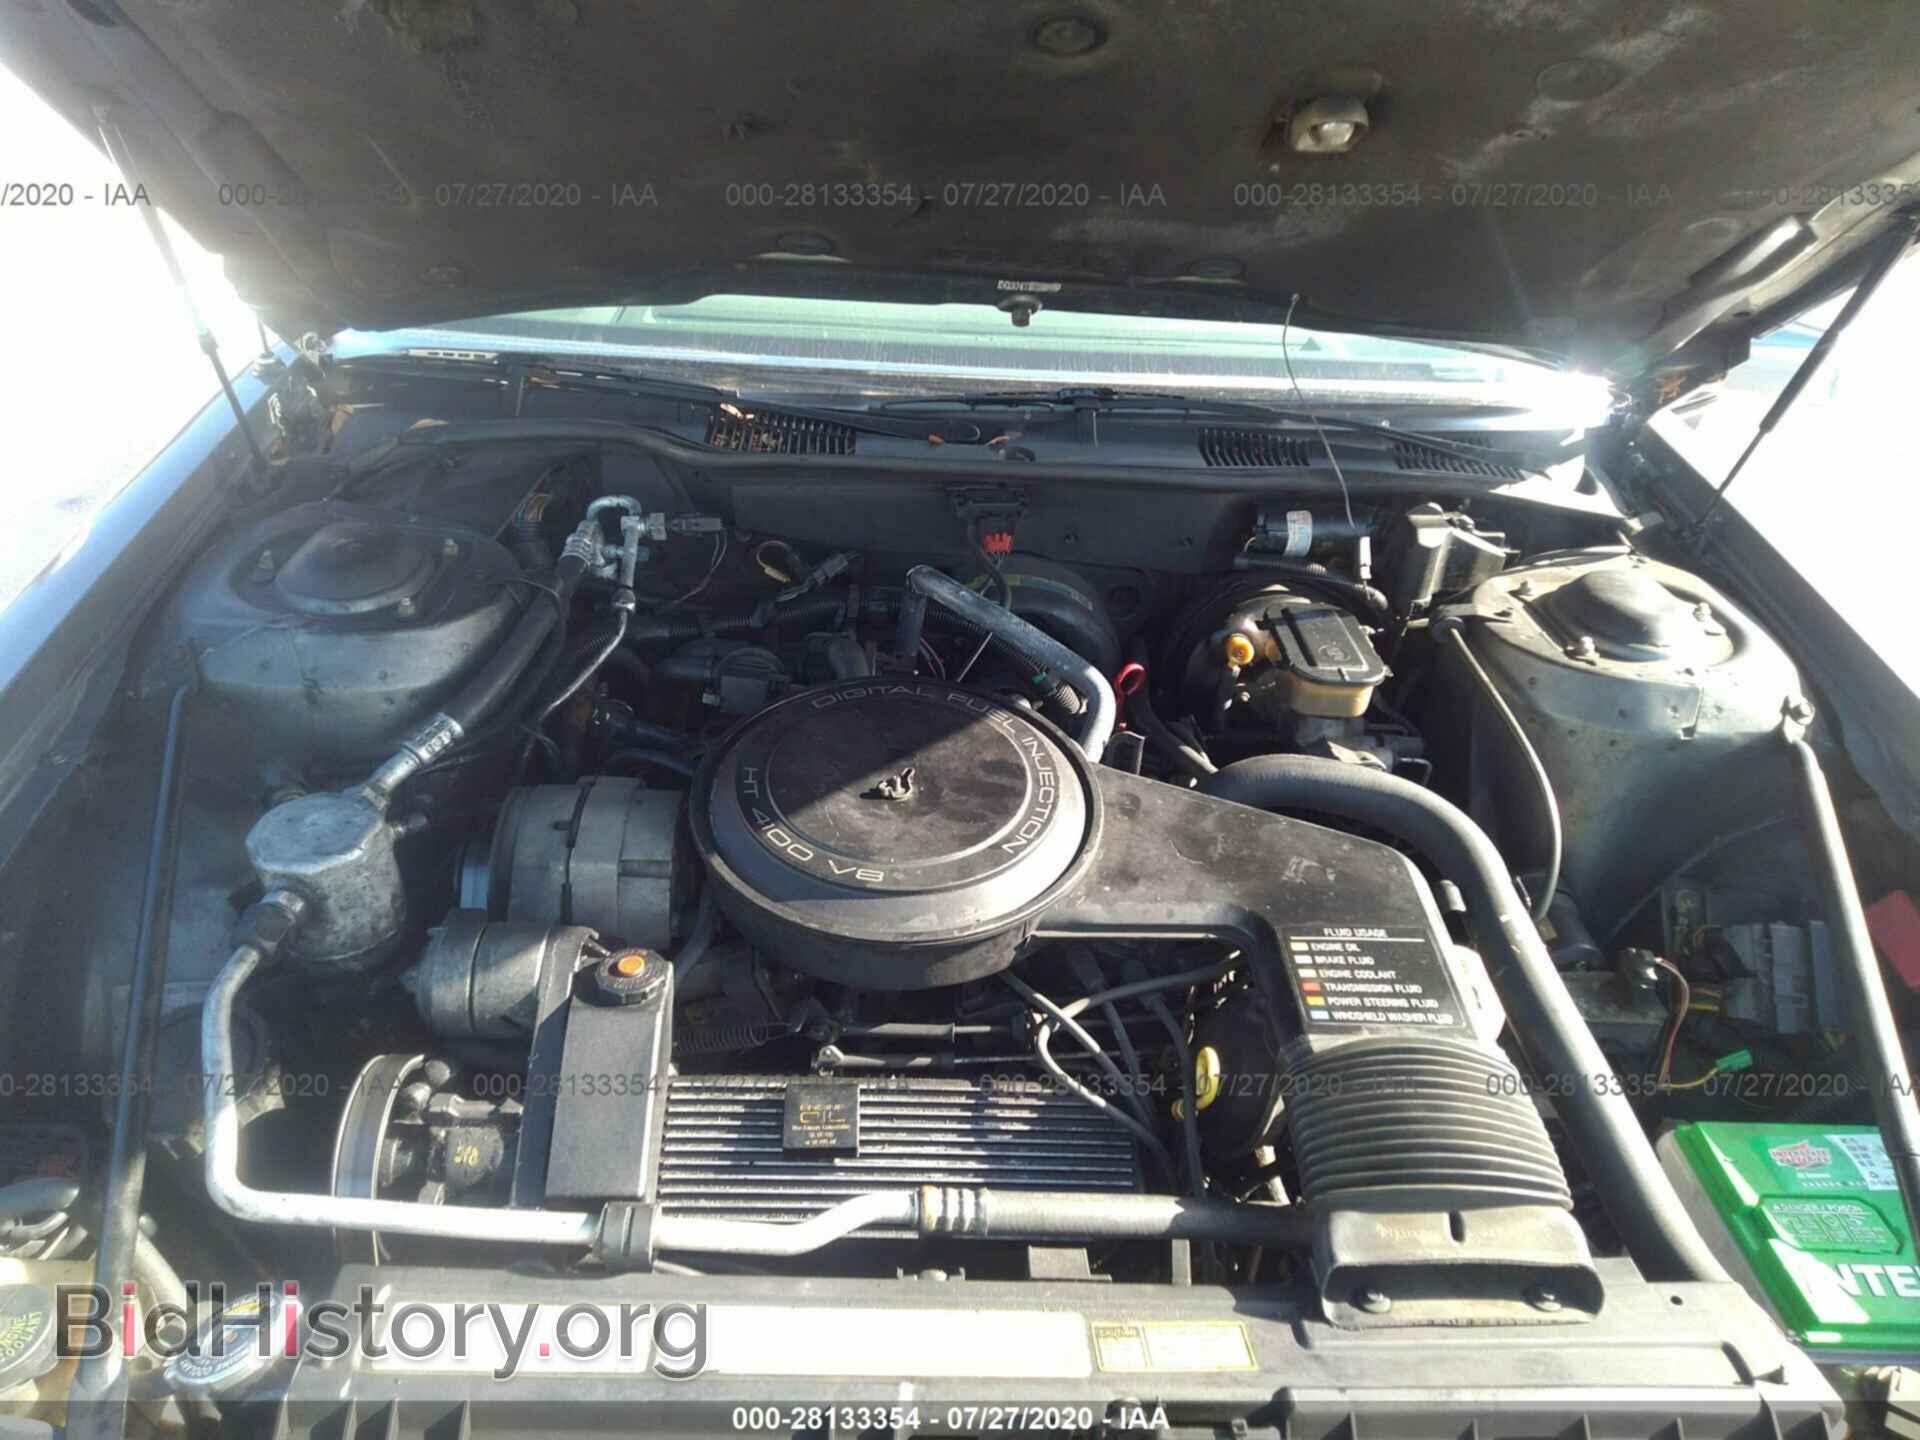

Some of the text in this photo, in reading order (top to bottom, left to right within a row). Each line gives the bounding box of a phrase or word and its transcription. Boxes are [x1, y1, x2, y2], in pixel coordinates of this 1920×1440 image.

[811, 684, 1057, 856] DIGITAL FUEL INJECTION
[742, 766, 886, 882] HT 4100 V8
[1323, 928, 1389, 939] FLUID USAGE
[1310, 943, 1361, 952] ENGINE OIL
[1315, 956, 1375, 966] BRAKE FLUID
[1320, 969, 1396, 979] ENGINE COOLANT
[1324, 983, 1422, 994] TRANSMISSION FLUID
[1327, 996, 1439, 1009] POWER STEERING FLUID
[1331, 1010, 1386, 1022] WINDSHIELD
